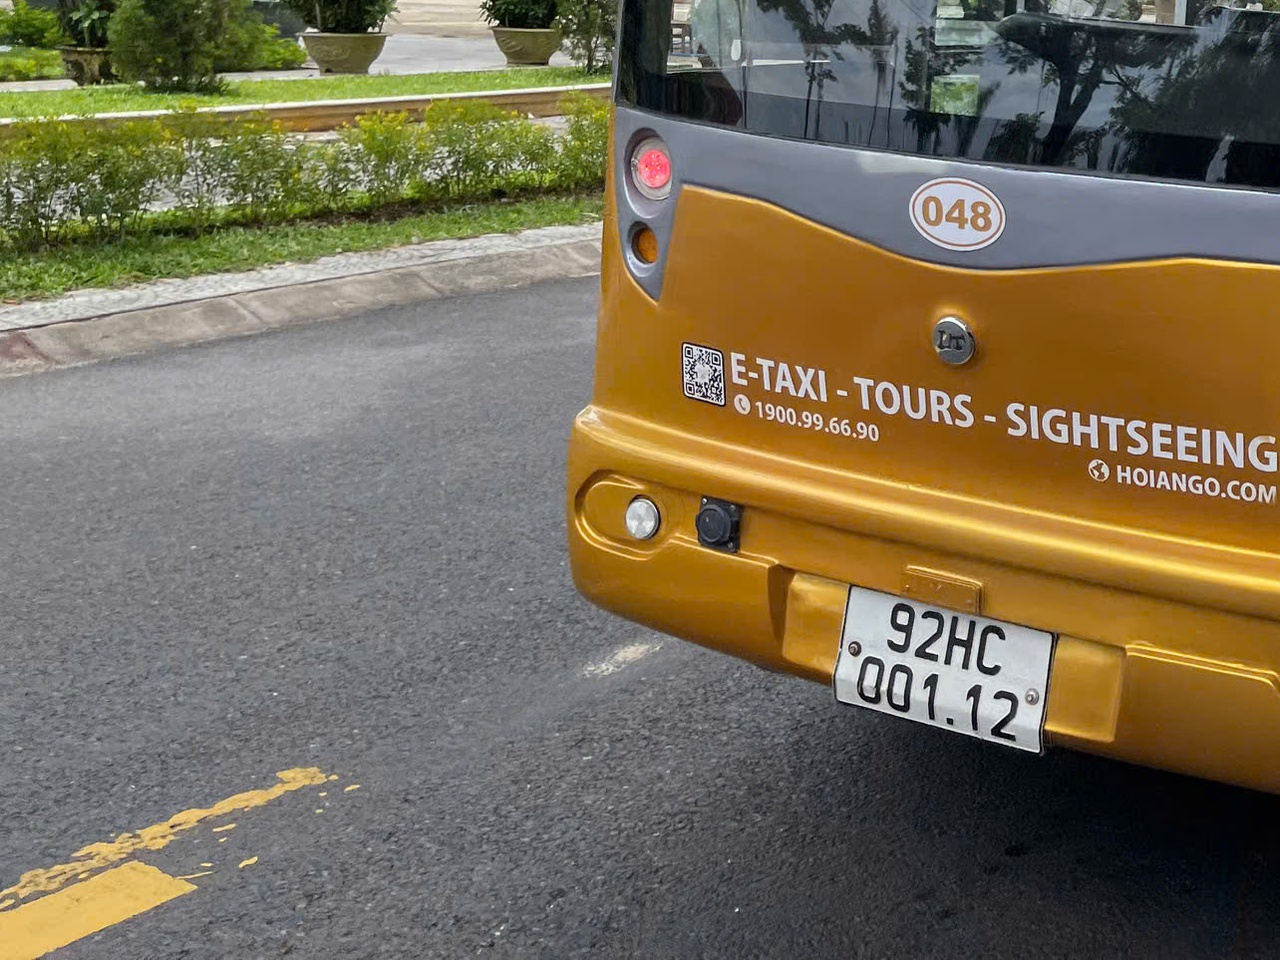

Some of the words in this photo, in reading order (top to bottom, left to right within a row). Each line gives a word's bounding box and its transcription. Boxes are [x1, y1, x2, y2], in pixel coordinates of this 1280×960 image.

[922, 196, 992, 232] 048
[730, 351, 828, 403] E-TAXI
[852, 376, 975, 429] TOURS
[1006, 402, 1278, 473] SIGHTSEEING
[754, 401, 879, 442] 1900.99.66.90
[1116, 464, 1277, 505] HOIANGO.COM
[887, 602, 1006, 676] 92HC
[857, 656, 1019, 742] 001.12
